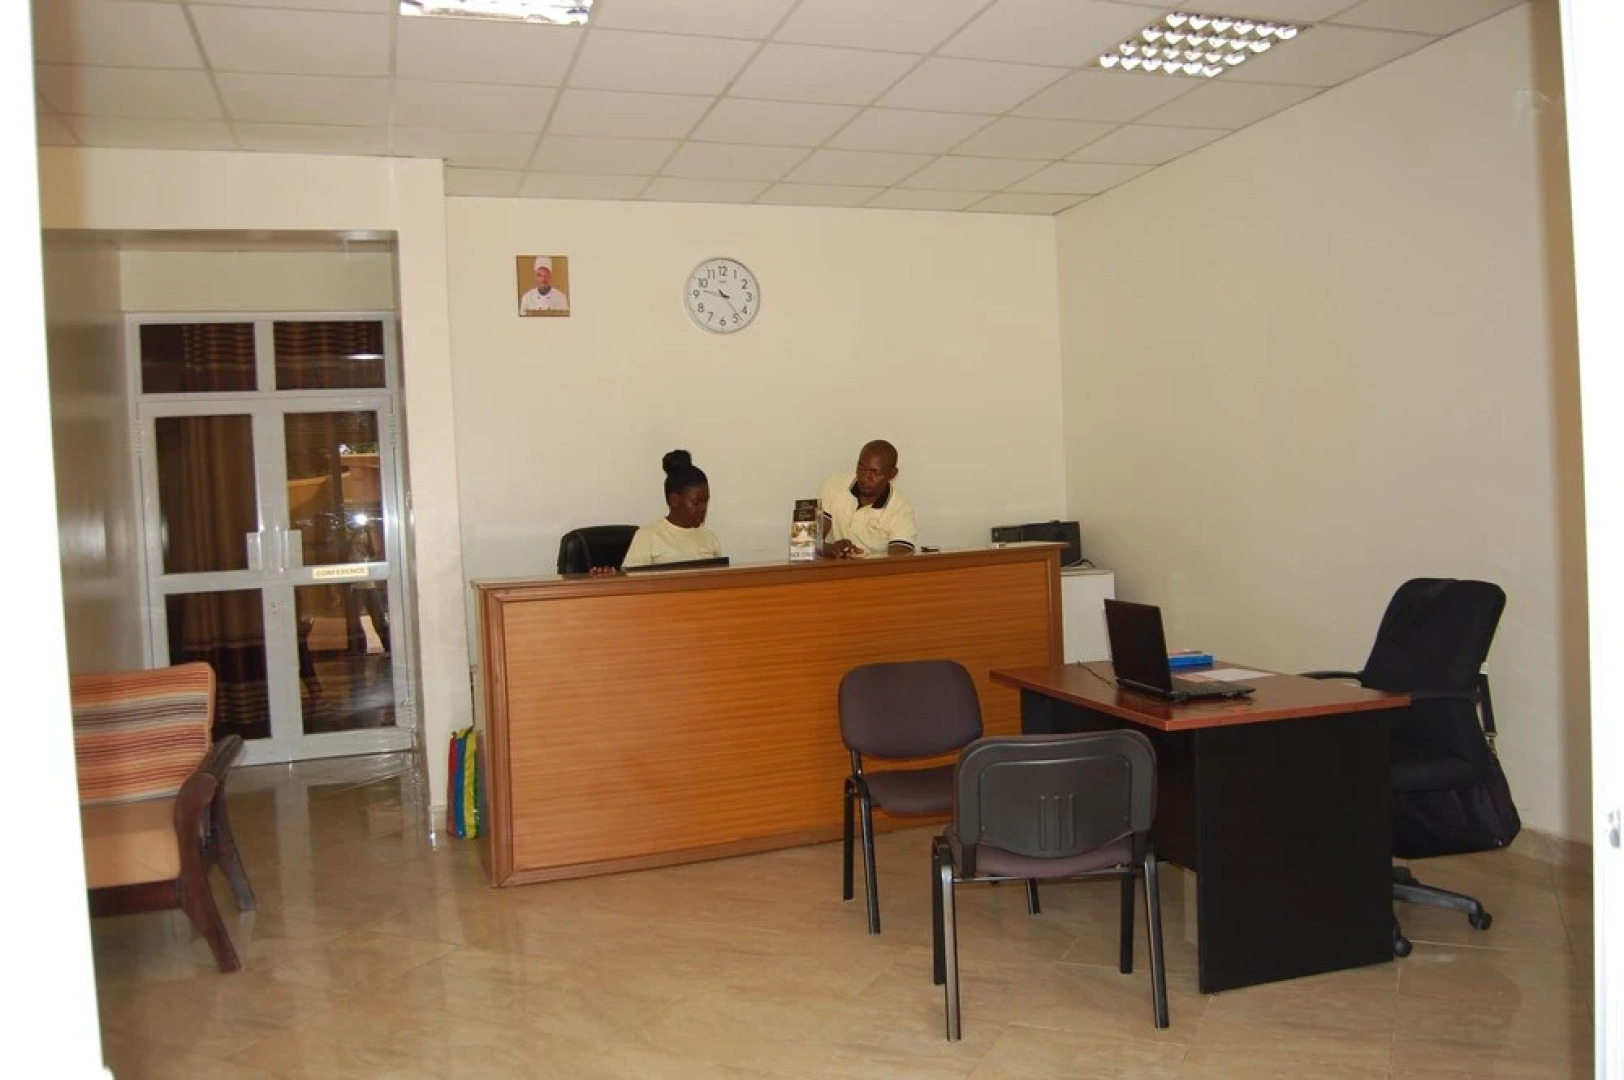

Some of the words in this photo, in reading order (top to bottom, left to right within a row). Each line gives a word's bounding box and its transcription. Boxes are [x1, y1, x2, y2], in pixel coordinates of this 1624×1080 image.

[707, 269, 715, 280] 11
[718, 265, 728, 276] 12
[698, 278, 708, 288] 10
[741, 279, 748, 289] 2
[693, 289, 700, 299] 9
[745, 292, 752, 302] 3
[698, 302, 704, 313] 8
[741, 305, 748, 314] 4
[708, 311, 713, 321] 7
[719, 316, 727, 326] 6
[732, 312, 739, 323] 5
[316, 567, 365, 577] CONFERENCE
